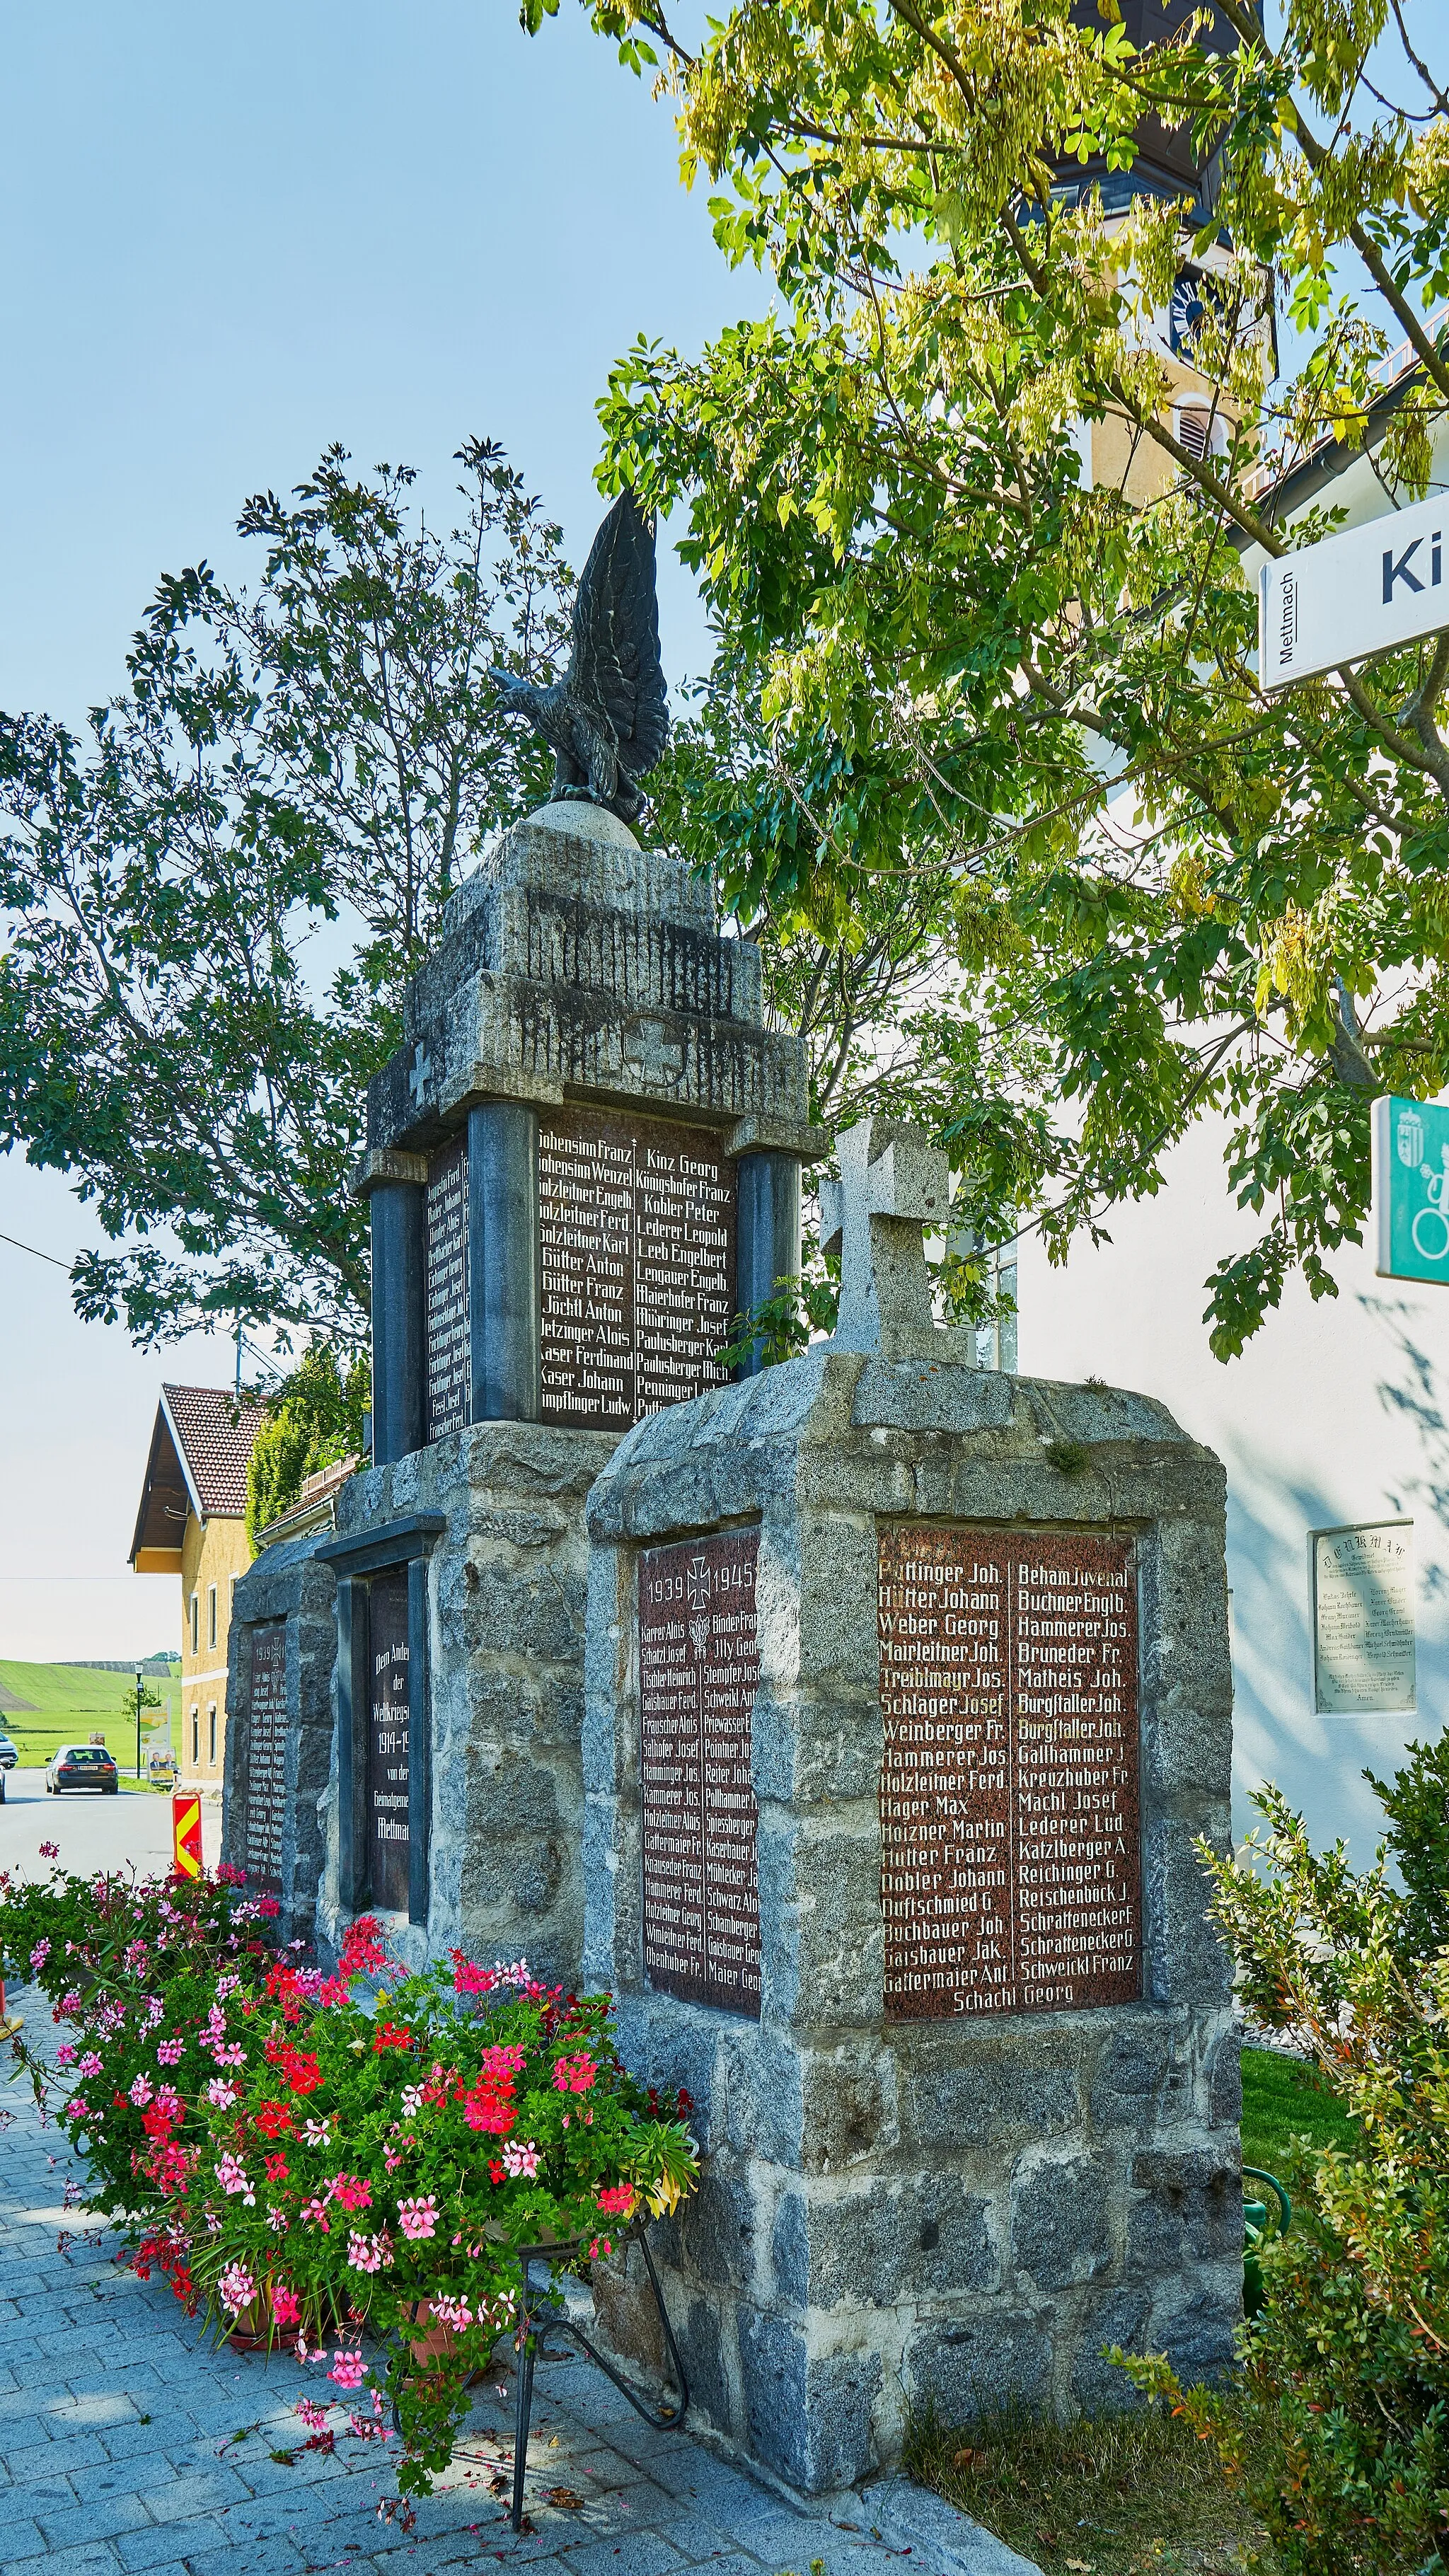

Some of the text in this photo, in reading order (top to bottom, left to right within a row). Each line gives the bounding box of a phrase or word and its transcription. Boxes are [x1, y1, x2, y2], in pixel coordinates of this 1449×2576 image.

[1280, 572, 1293, 665] Mettmach
[591, 1162, 633, 1186] Wenzel
[647, 1148, 717, 1182] Kinz Georg
[636, 1169, 730, 1203] Königshofer Franz
[645, 1194, 720, 1223] Kobler Peter
[637, 1215, 727, 1247] Lederer Leopold
[603, 1233, 629, 1254] Karl
[638, 1238, 727, 1269] Leeb Engelbert
[586, 1254, 624, 1276] Anton
[637, 1261, 729, 1292] Lengauer Engelb.
[587, 1277, 624, 1300] Franz
[636, 1283, 729, 1314] Maierhofer Franz
[584, 1300, 622, 1322] Anton
[596, 1325, 630, 1346] Alois
[697, 1315, 729, 1336] Josef
[637, 1329, 705, 1357] Paulusberger
[637, 1352, 701, 1379] Paulusberger
[637, 1375, 693, 1401] Penninger
[649, 1563, 752, 1603] 1939 1945
[879, 1585, 999, 1610] Hütter Johann
[1018, 1590, 1128, 1617] Buchner Englb.
[641, 1620, 685, 1643] Karrer Alois
[712, 1612, 741, 1634] Binder
[879, 1613, 998, 1640] Weber Georg
[1018, 1617, 1131, 1638] Hammerer Jos.
[642, 1644, 686, 1665] Schatzl Josef
[879, 1640, 1003, 1662] Mairleitner Joh.
[1018, 1642, 1122, 1663] Bruneder Fr.
[393, 1674, 404, 1690] der
[642, 1667, 696, 1687] Tischler Heinrich
[704, 1663, 741, 1685] Stempfer
[880, 1668, 1005, 1691] Treiblmayr Jos.
[1018, 1668, 1126, 1687] Matheis Joh.
[642, 1691, 698, 1711] Gaisbauer Ferd.
[705, 1688, 739, 1708] Schweikl
[881, 1694, 1005, 1718] Schlager Josef
[642, 1715, 698, 1734] Frauscher Alois
[705, 1714, 745, 1733] Priewasser
[883, 1719, 1004, 1745] Weinberger Fr.
[643, 1738, 699, 1760] Salhofer Josef
[387, 1764, 409, 1780] von der
[643, 1762, 700, 1784] Hamminger Jos.
[1018, 1767, 1128, 1789] Kreuzhuber Fr.
[643, 1785, 700, 1806] Kammerer Jos.
[705, 1788, 750, 1809] Pollhammer
[1019, 1791, 1117, 1812] Machl Josef
[644, 1808, 700, 1831] Holzleitner Alois
[881, 1796, 969, 1820] Hager Max
[706, 1813, 755, 1839] Spiessberger
[952, 1818, 1005, 1839] Martin
[1019, 1816, 1087, 1836] Lederer
[645, 1832, 702, 1855] Gattermaier Fr.
[1020, 1837, 1130, 1860] Katzlberger A.
[645, 1854, 702, 1880] Knauseder Franz
[707, 1862, 745, 1885] Mühlecker
[1019, 1860, 1119, 1885] Reichinger G.
[645, 1878, 703, 1904] Hammerer Ferd.
[882, 1869, 1005, 1892] Dobler Johann
[645, 1900, 702, 1932] Holzleitner Georg
[645, 1923, 704, 1952] Wimleitner Ferd.
[884, 1915, 1008, 1943] Buchbauer Joh.
[646, 1946, 701, 1977] Obenhuber Fr.
[1021, 1956, 1133, 1980] Schweickl Franz
[954, 1985, 1073, 2013] Schachl Georg
